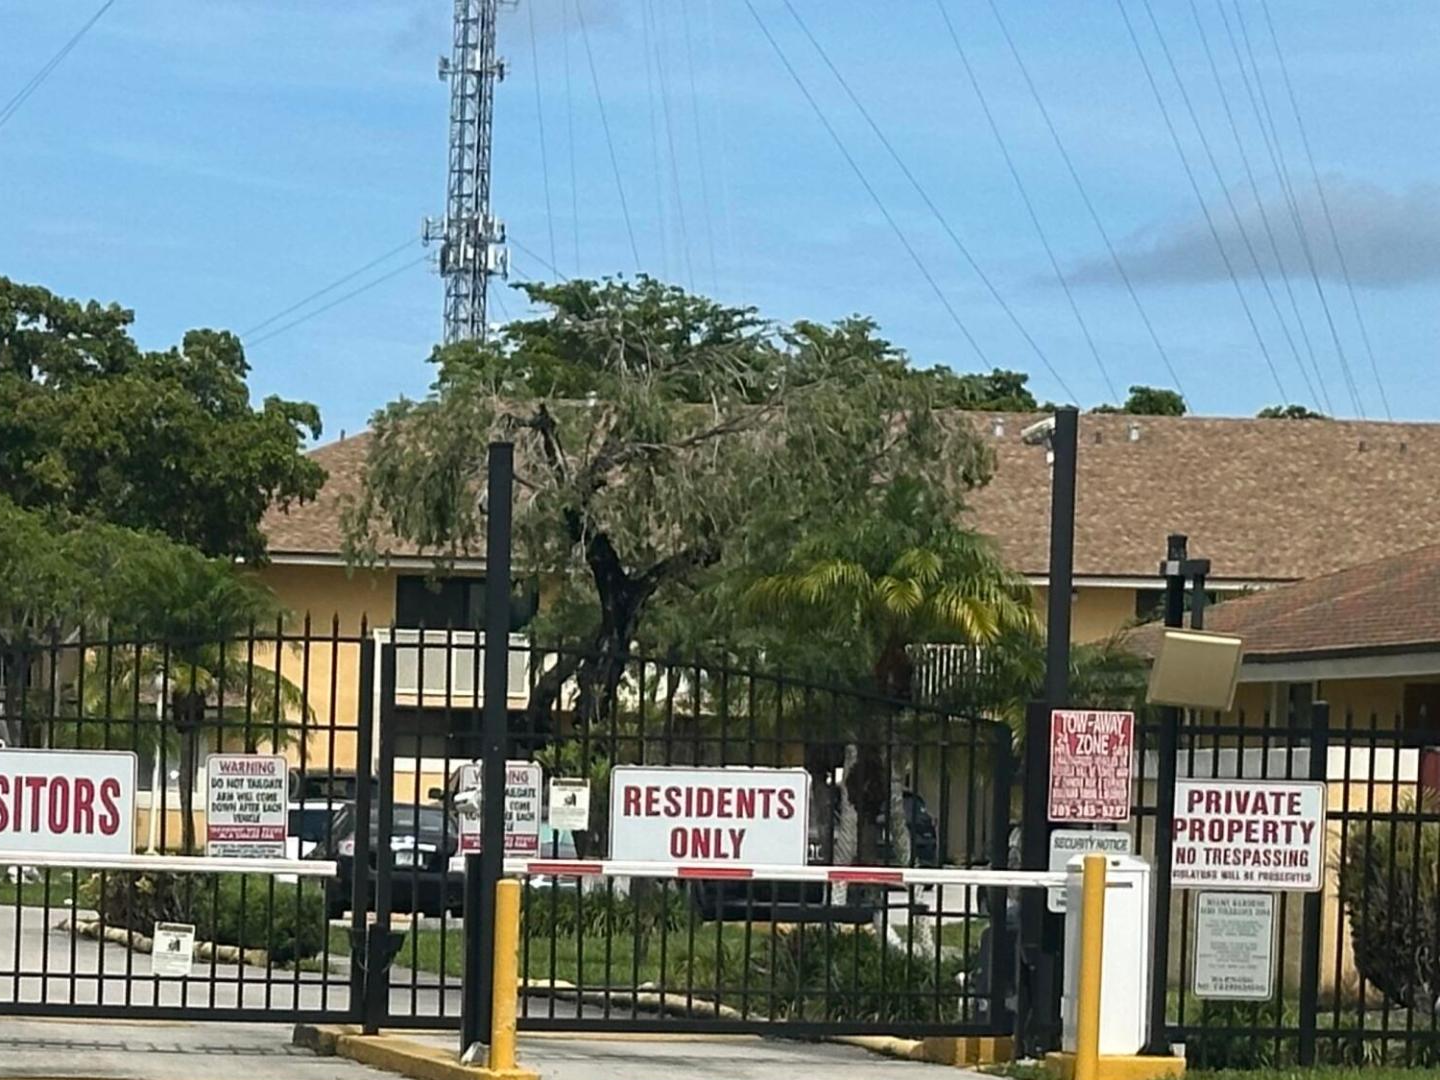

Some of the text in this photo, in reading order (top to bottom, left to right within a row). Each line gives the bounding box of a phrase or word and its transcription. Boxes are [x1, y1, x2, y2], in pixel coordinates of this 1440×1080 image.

[1062, 713, 1125, 735] TOW-AWAY
[1076, 734, 1110, 755] ZONE
[219, 761, 275, 774] WARNING
[226, 777, 244, 789] NOT
[623, 785, 796, 820] RESIDENTS
[1187, 789, 1302, 816] PRIVATE
[1172, 817, 1316, 844] PROPERTY
[670, 827, 747, 860] ONLY
[1054, 837, 1128, 851] SECURITY NOTICE
[1176, 847, 1309, 868] NO TRESPASSING
[1221, 870, 1241, 881] WILL
